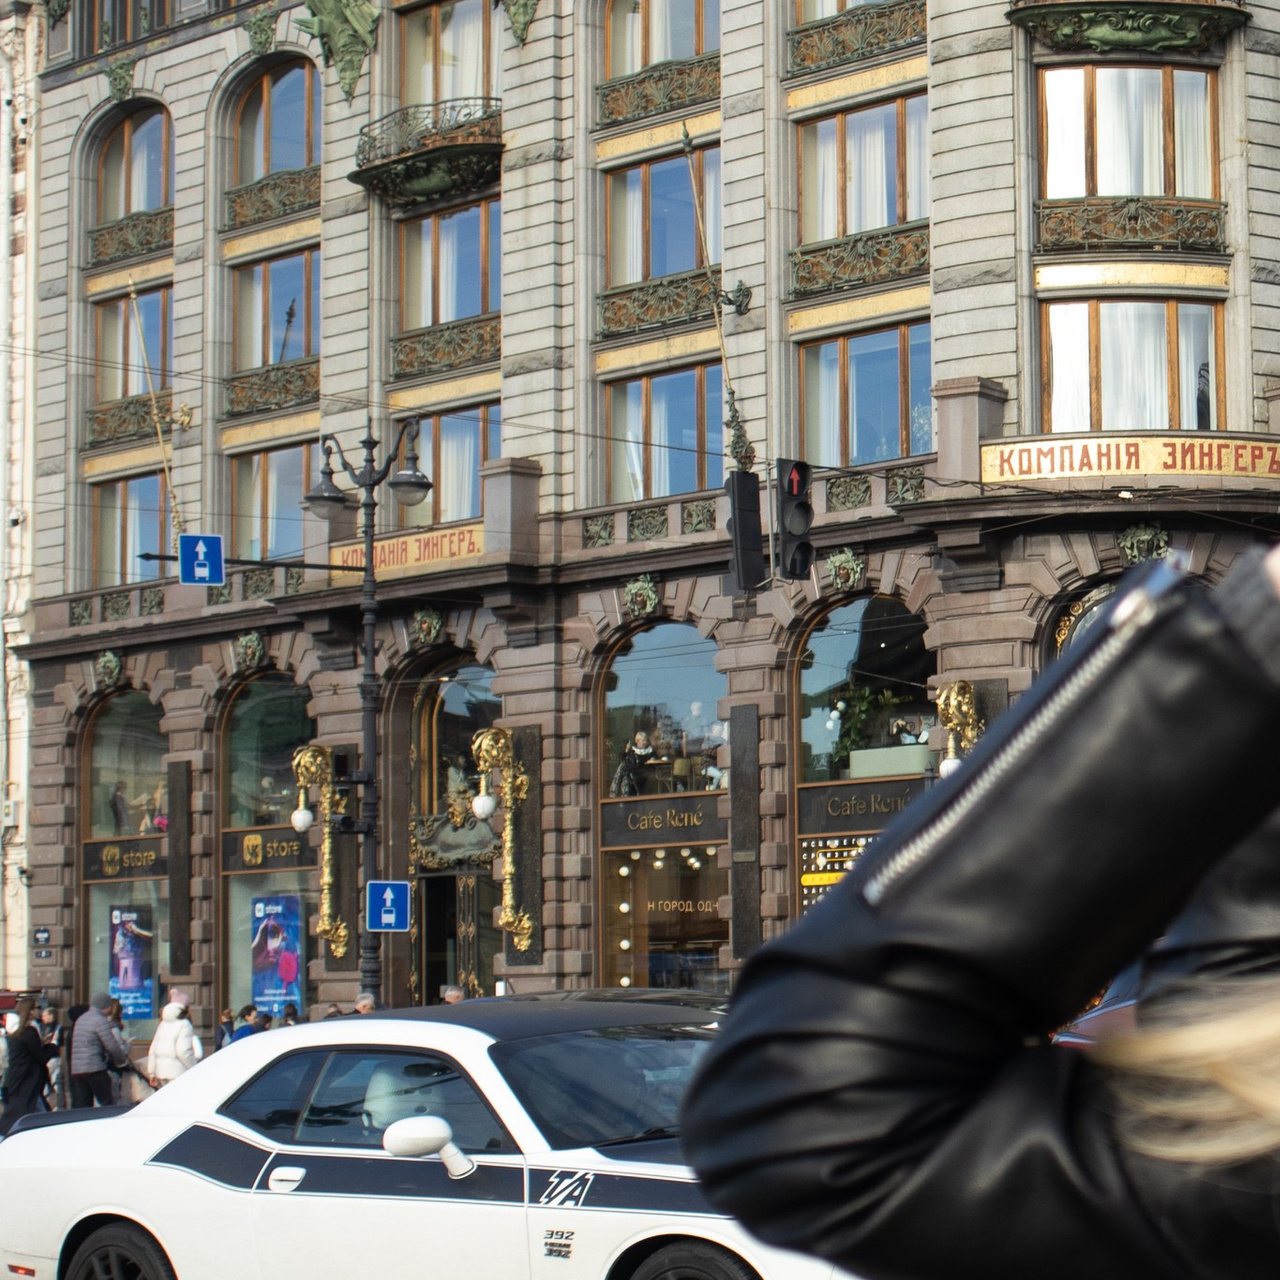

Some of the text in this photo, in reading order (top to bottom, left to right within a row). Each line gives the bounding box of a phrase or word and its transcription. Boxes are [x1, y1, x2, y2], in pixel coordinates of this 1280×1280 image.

[1000, 442, 1140, 477] КОМПАНІЯ
[828, 795, 866, 816] Cafe
[627, 803, 704, 831] Cafe René
[266, 839, 300, 858] store
[122, 850, 156, 868] store
[543, 1229, 575, 1241] 392
